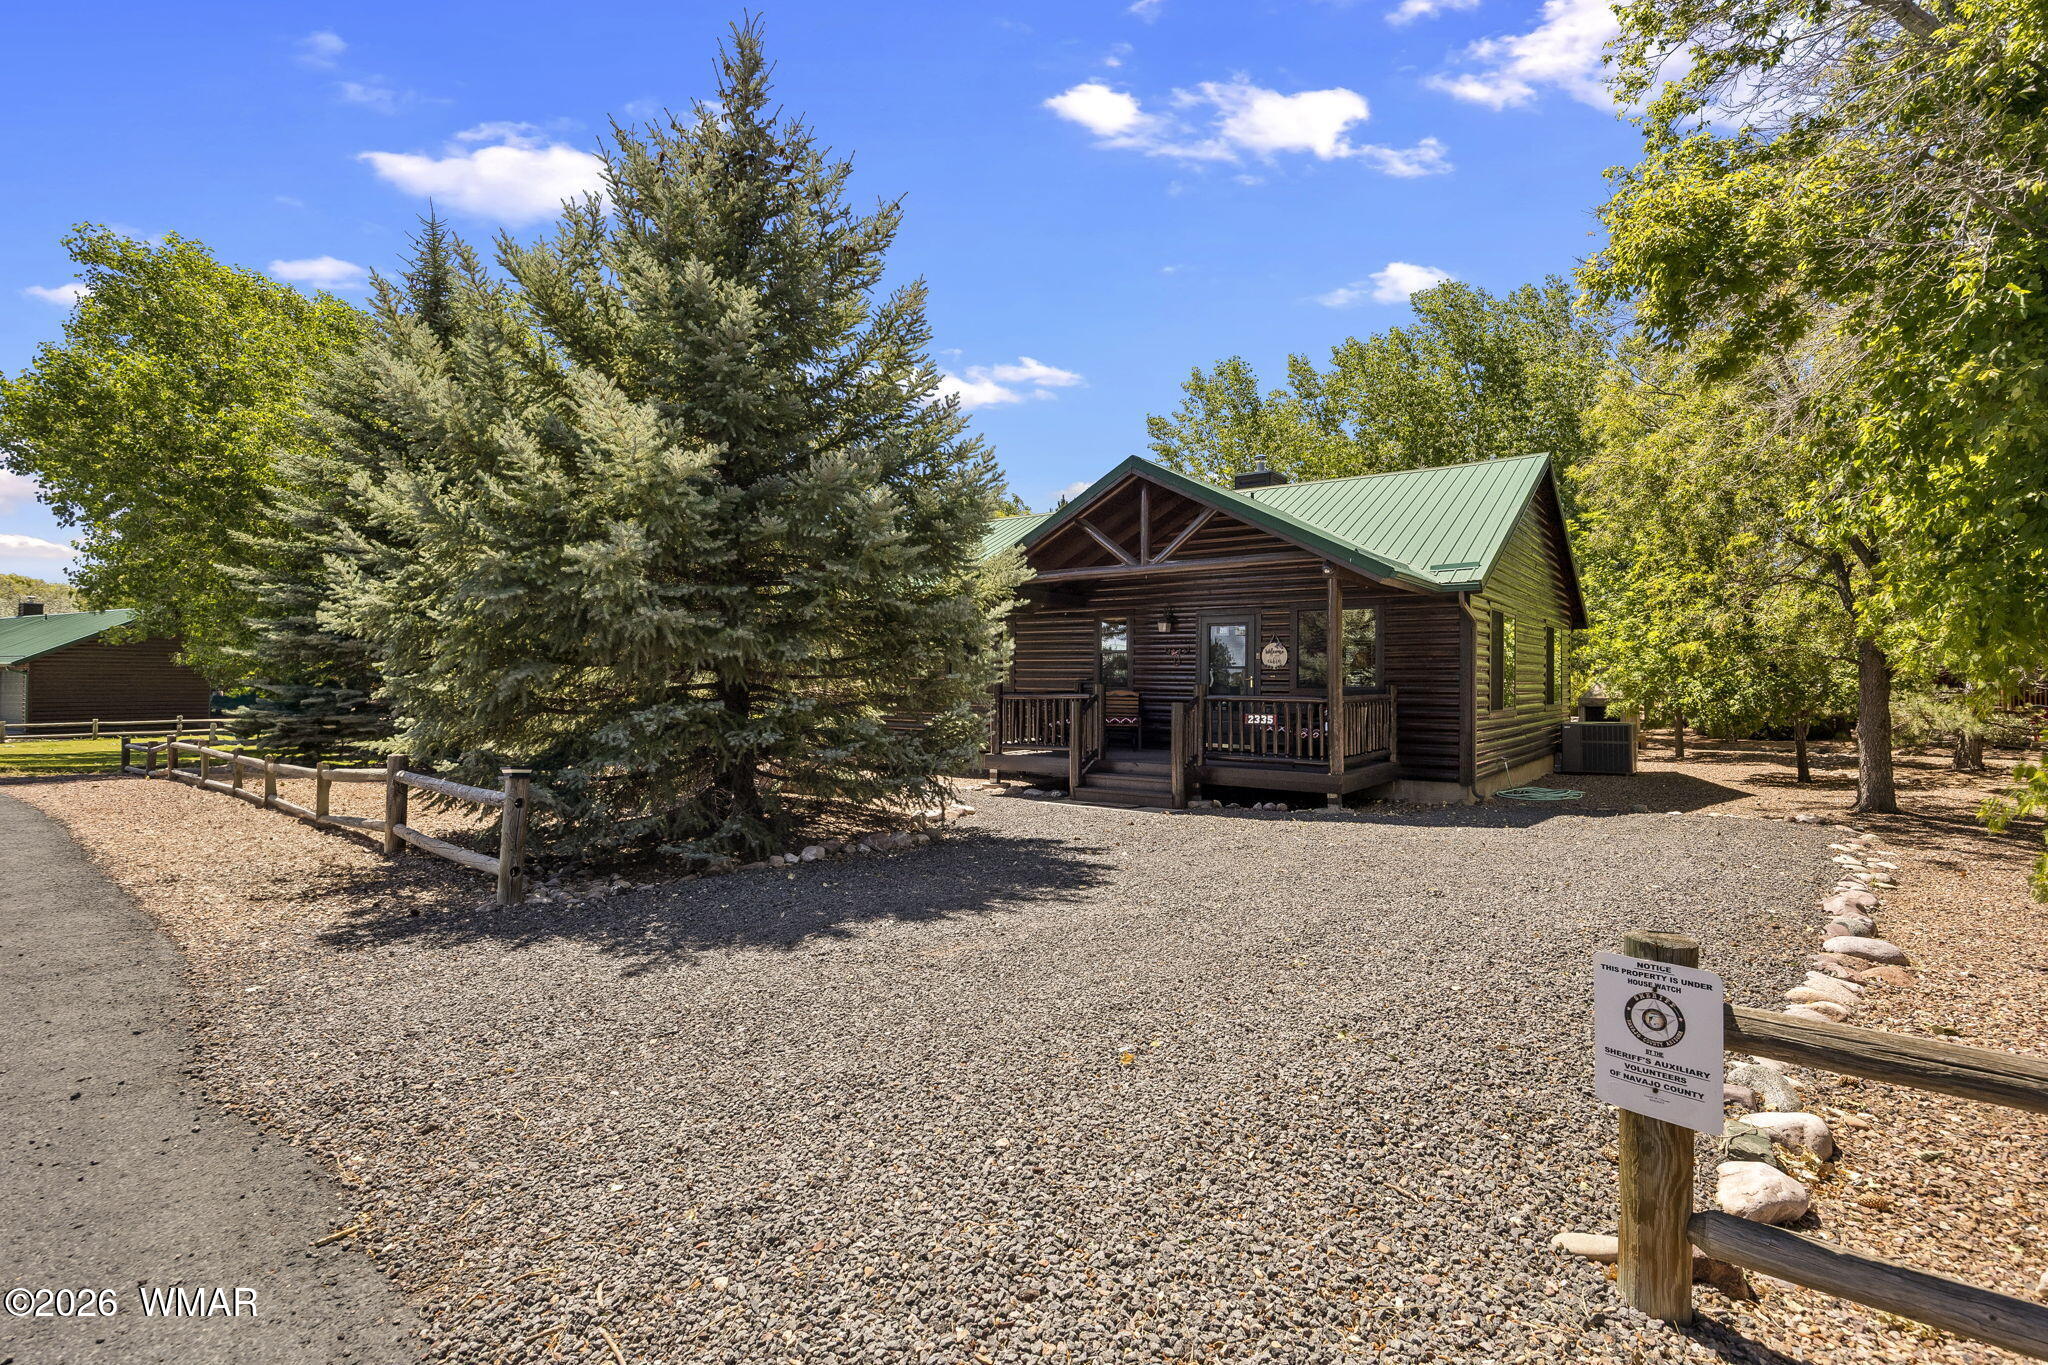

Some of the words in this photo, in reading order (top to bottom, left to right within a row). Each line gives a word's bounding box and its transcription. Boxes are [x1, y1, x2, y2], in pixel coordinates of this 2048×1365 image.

[1247, 714, 1274, 724] 2335
[1600, 963, 1619, 973] THIS
[1621, 968, 1667, 982] PROPERTY
[1669, 976, 1679, 985] IS
[1681, 979, 1713, 991] UNDER
[1636, 962, 1672, 973] NOTICE
[1627, 978, 1653, 989] HOUSE
[1653, 982, 1682, 994] WATCH
[1604, 1046, 1652, 1065] SHERIFF'S
[1654, 1060, 1711, 1079] AUXILIARY
[1653, 1051, 1665, 1059] THE
[1624, 1062, 1687, 1084] VOLUNTEERS
[1609, 1069, 1621, 1077] OF
[1623, 1073, 1661, 1088] NAVAJO
[1663, 1084, 1705, 1100] COUNTY
